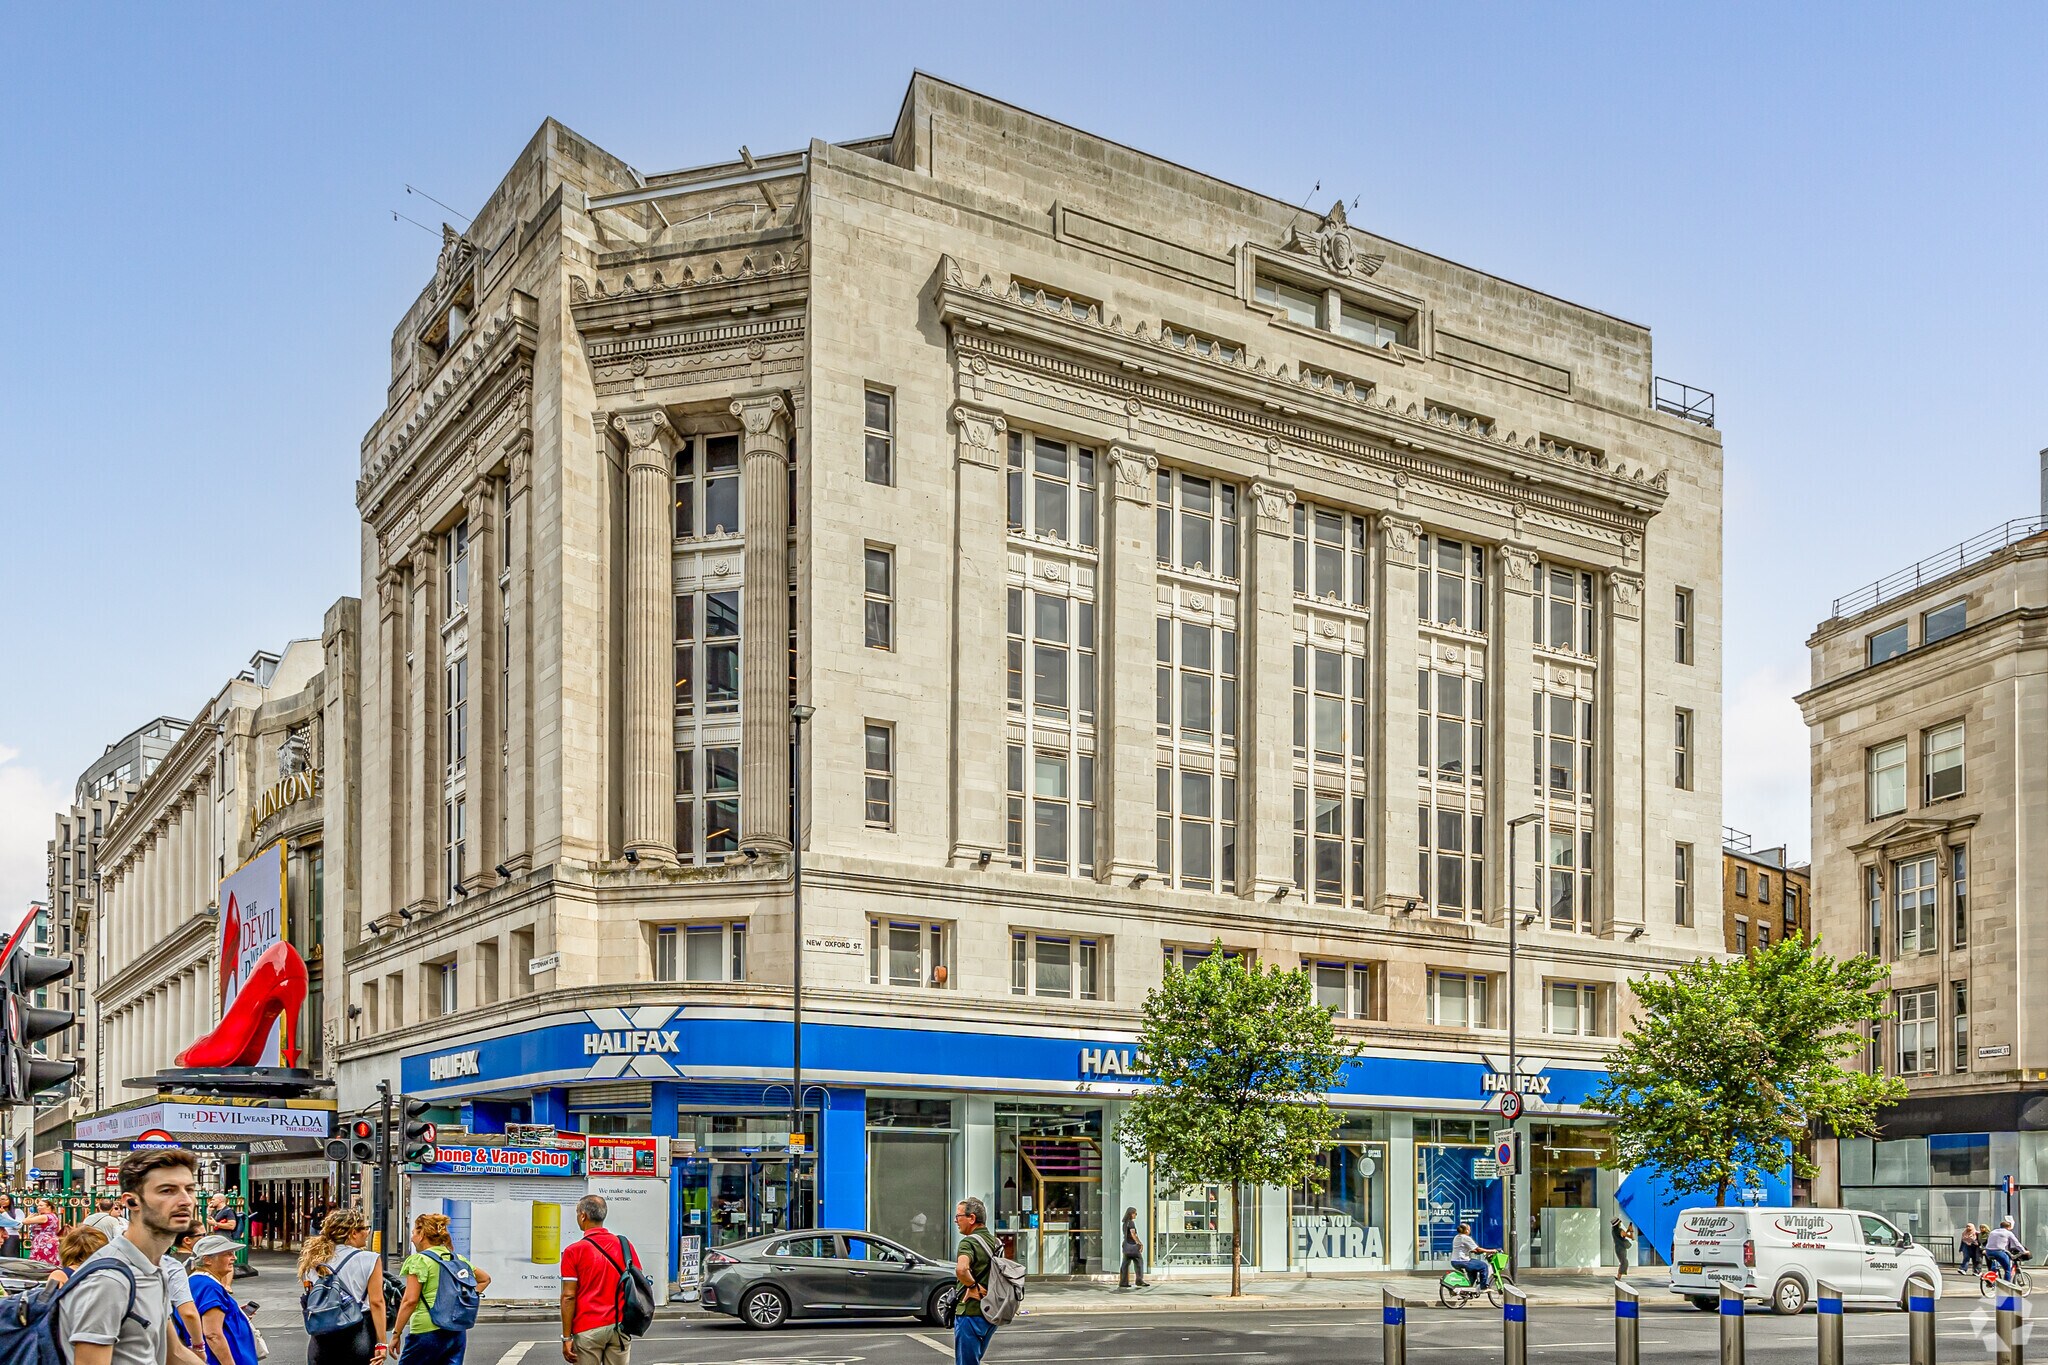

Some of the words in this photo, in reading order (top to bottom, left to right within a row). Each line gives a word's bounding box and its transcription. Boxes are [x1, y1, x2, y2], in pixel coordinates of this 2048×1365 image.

[249, 767, 318, 842] MINION
[246, 901, 257, 920] THE
[47, 923, 55, 956] HOT
[242, 908, 277, 954] DEVIL
[806, 939, 822, 947] NEW
[825, 940, 851, 949] OXFORD
[584, 1030, 680, 1055] HALIFAX
[429, 1050, 480, 1081] HALIFAX
[1081, 1048, 1152, 1077] HALI
[1502, 1098, 1516, 1112] 20
[195, 1110, 245, 1125] DEVIL
[244, 1115, 270, 1123] WEARS
[271, 1113, 322, 1127] PRADA
[619, 1138, 647, 1146] Repairing
[435, 1147, 472, 1163] hone
[475, 1148, 488, 1163] &
[491, 1149, 528, 1166] Vape
[531, 1150, 568, 1168] Shop
[508, 1166, 521, 1174] You
[1328, 1215, 1352, 1228] YOU
[1690, 1216, 1728, 1229] Whitgift
[1783, 1215, 1825, 1229] Whitgift
[1697, 1227, 1717, 1237] Hire
[1796, 1228, 1817, 1240] Hire
[1292, 1227, 1384, 1258] EXTRA
